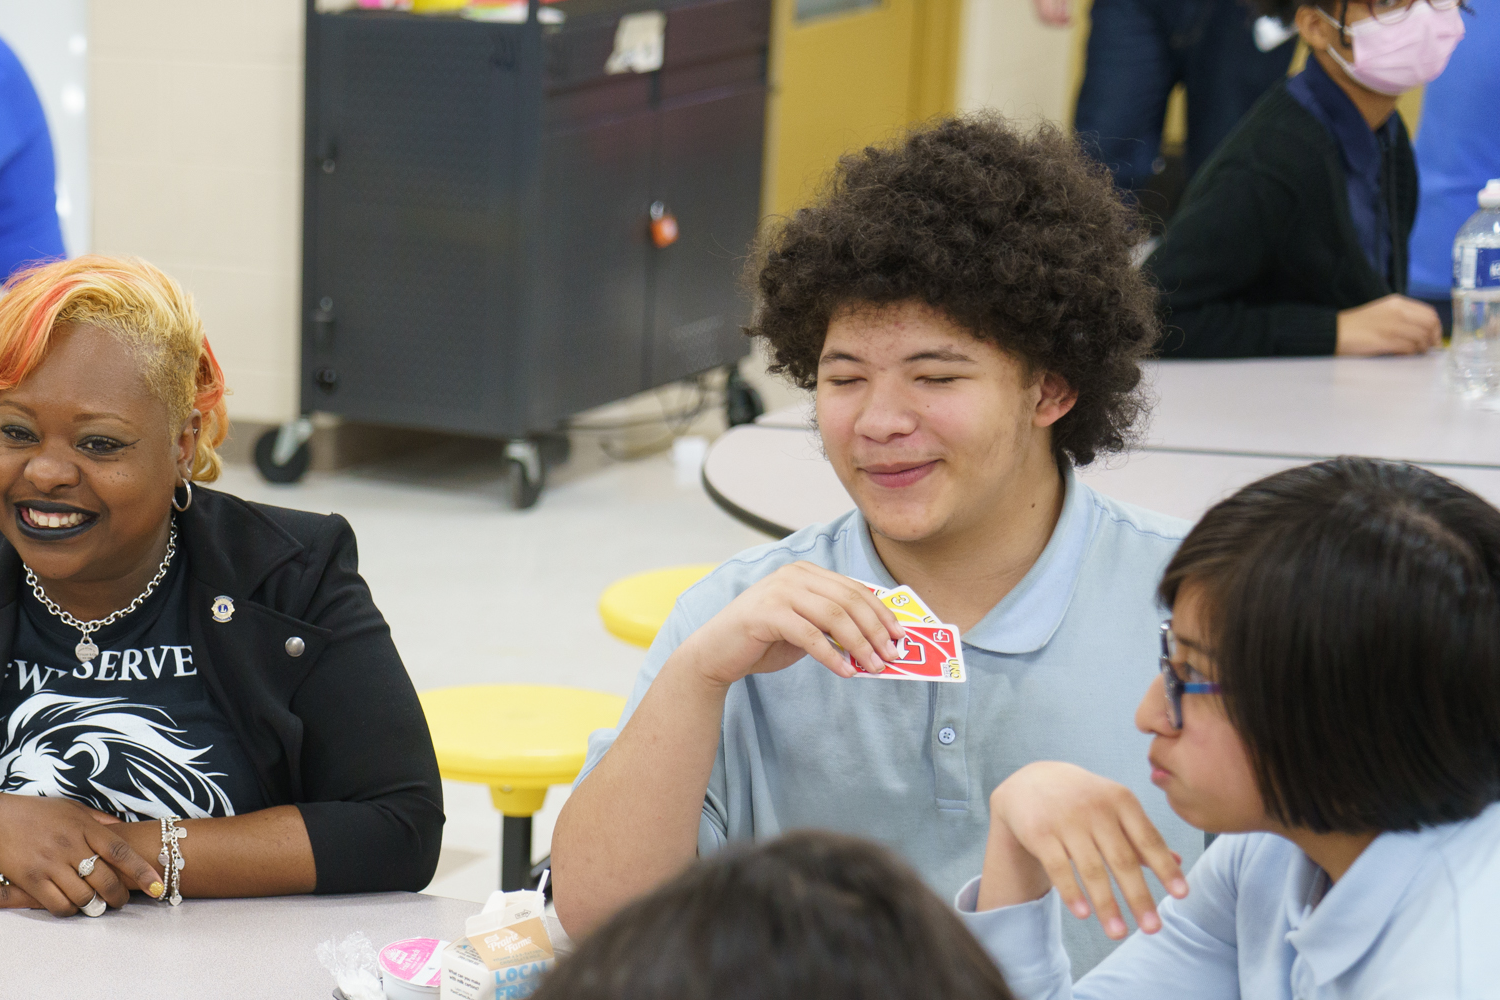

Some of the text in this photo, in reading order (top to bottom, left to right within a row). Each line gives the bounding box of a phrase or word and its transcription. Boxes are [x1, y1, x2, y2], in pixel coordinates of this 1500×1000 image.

[891, 594, 911, 607] 3
[72, 645, 198, 682] SERVE
[947, 658, 962, 680] UNO
[487, 932, 519, 952] Prairie
[504, 936, 532, 954] Farms
